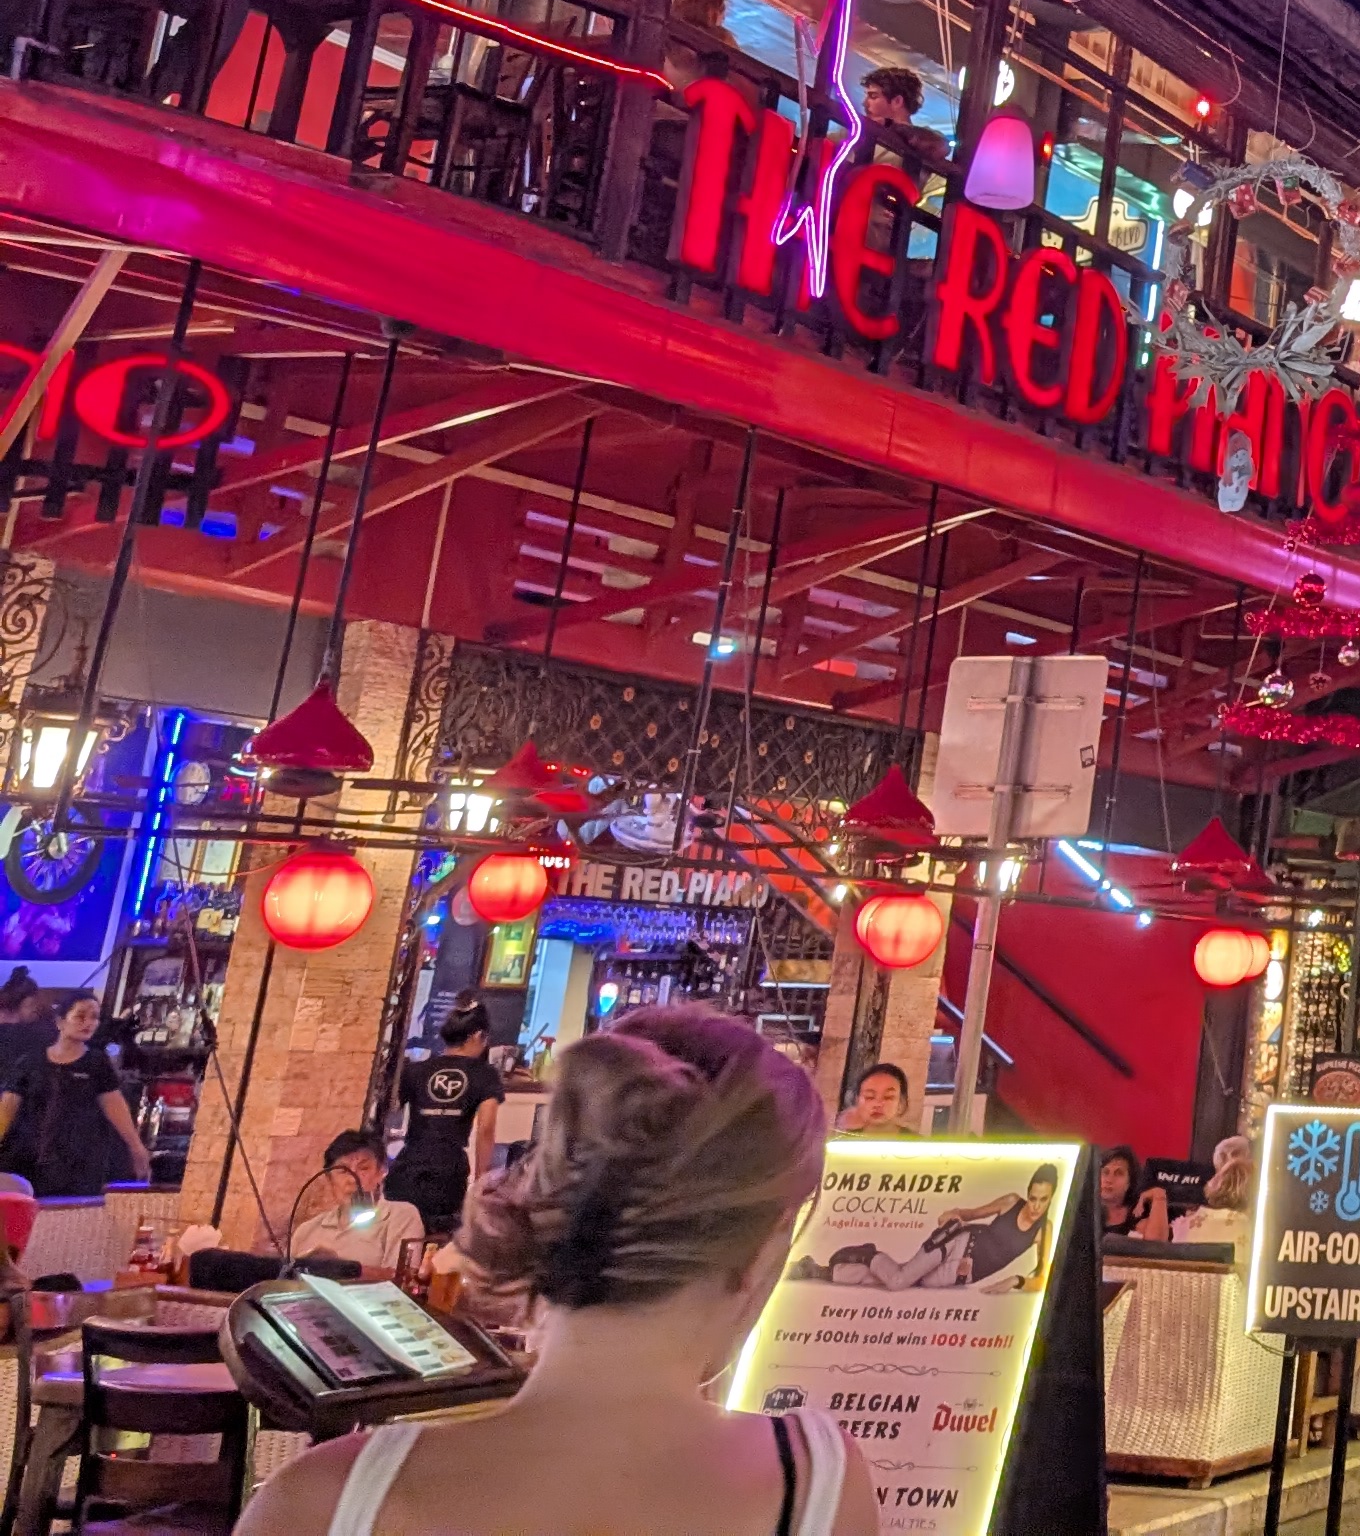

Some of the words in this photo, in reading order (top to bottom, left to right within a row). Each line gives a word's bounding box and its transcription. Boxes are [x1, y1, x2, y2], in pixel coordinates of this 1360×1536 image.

[681, 75, 921, 340] THE
[934, 200, 1128, 424] RED
[556, 859, 617, 899] THE
[619, 866, 680, 903] RED
[433, 1074, 462, 1096] RP
[823, 1171, 871, 1193] OMB
[878, 1173, 963, 1194] RAIDER
[832, 1195, 929, 1215] COCKTAIL
[822, 1216, 879, 1231] Angelina's
[880, 1218, 925, 1230] Favorite
[821, 1305, 858, 1321] Every
[896, 1307, 926, 1321] sold
[929, 1308, 941, 1321] is
[944, 1309, 980, 1322] FREE
[774, 1329, 812, 1345] Every
[862, 1331, 893, 1345] sold
[896, 1332, 928, 1346] wins
[828, 1392, 922, 1413] BELGIAN
[931, 1401, 998, 1434] Duvel
[894, 1486, 960, 1509] TOWN
